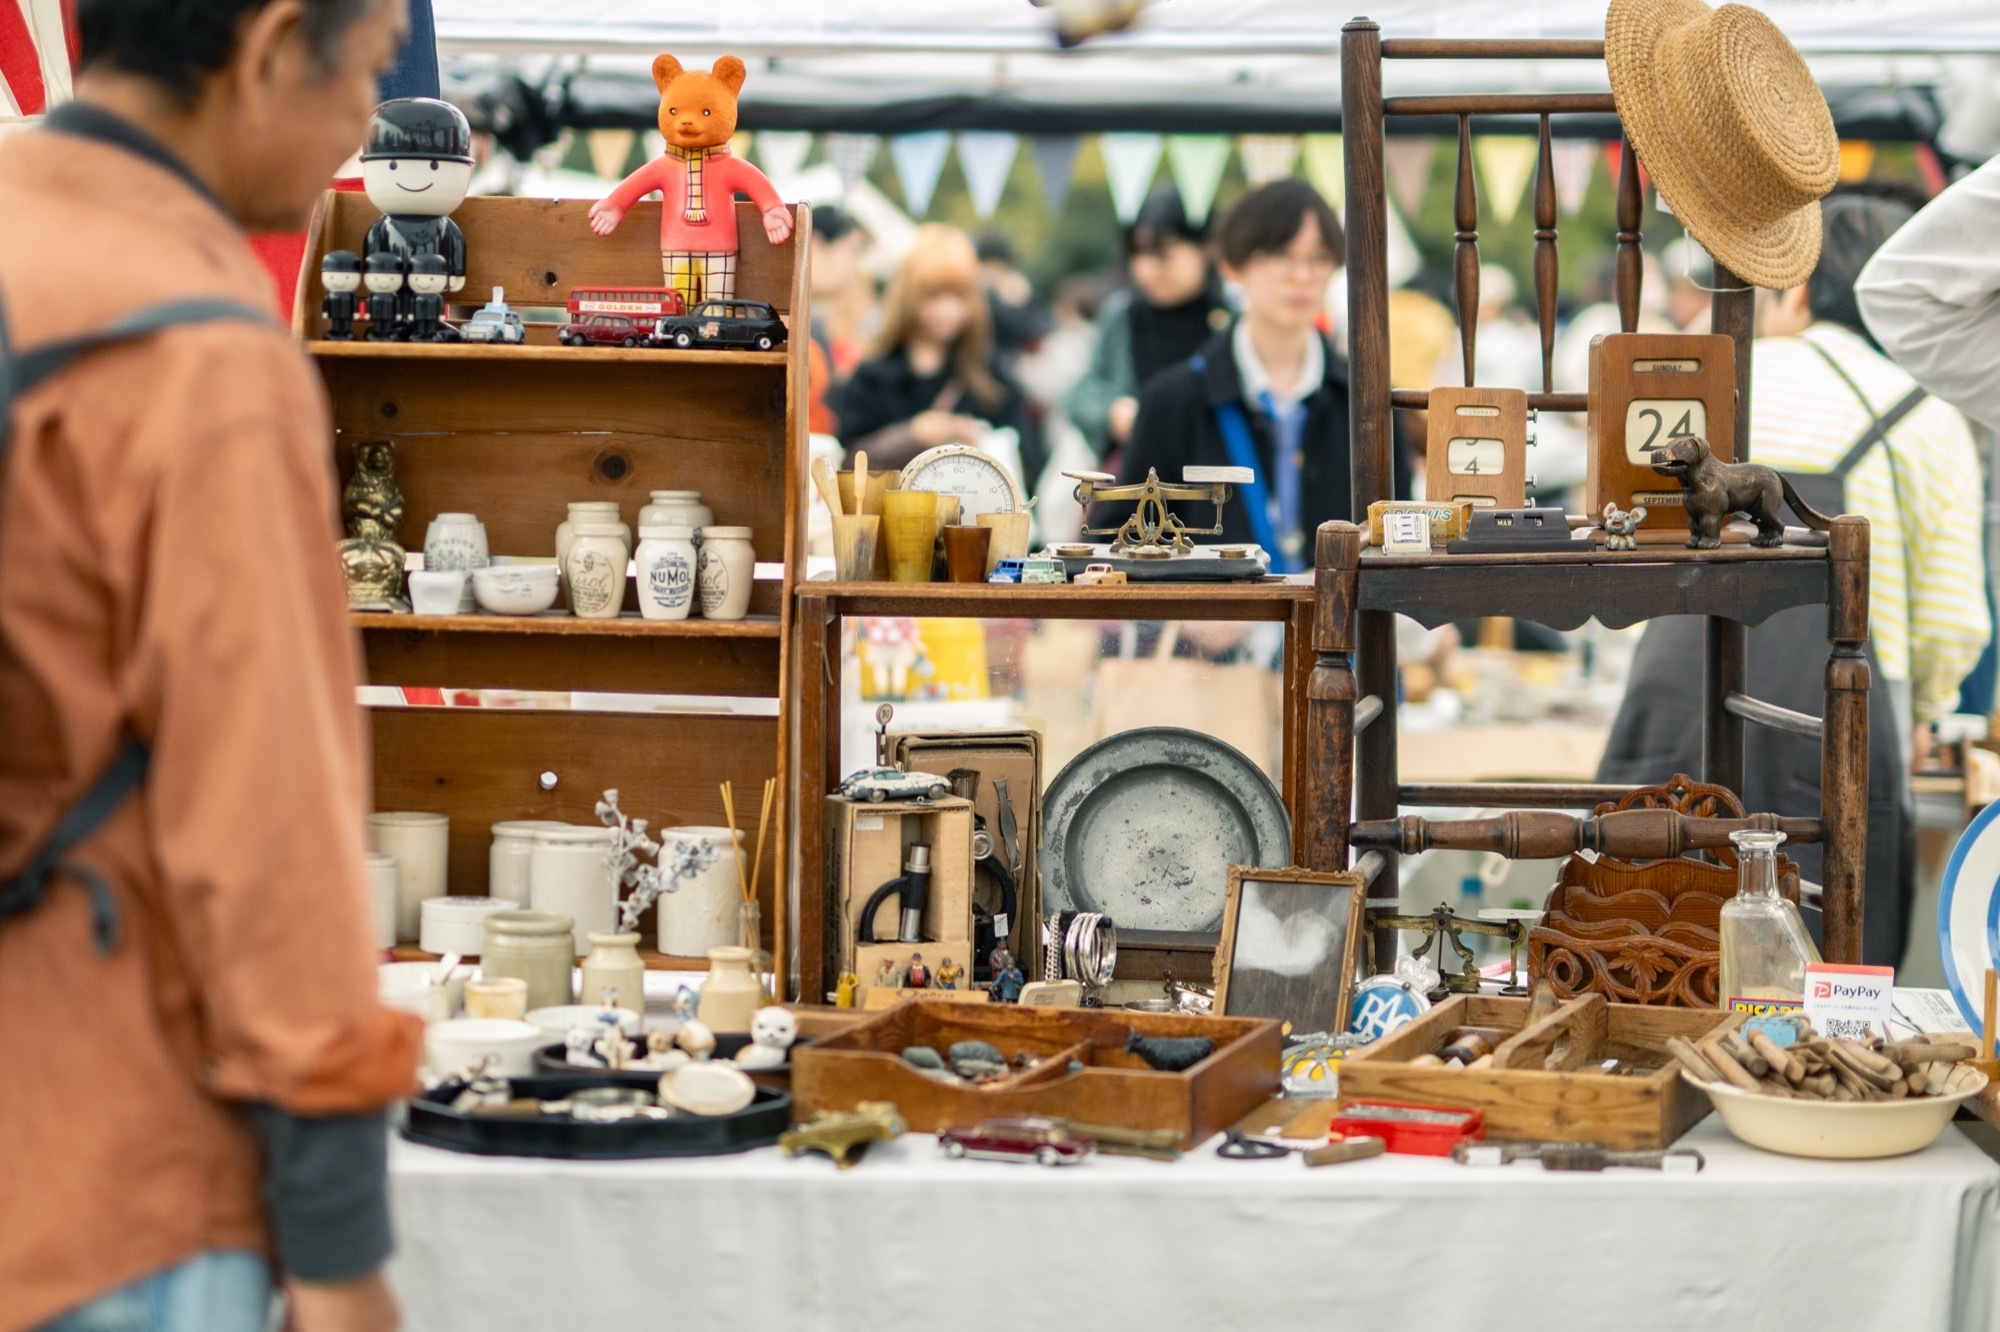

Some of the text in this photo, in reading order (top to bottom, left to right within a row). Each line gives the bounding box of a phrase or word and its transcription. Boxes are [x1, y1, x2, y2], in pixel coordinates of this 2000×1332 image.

[1652, 364, 1682, 372] SUNDAY
[1638, 408, 1696, 452] 24
[953, 466, 966, 474] 60
[1464, 455, 1480, 475] 4
[933, 471, 944, 479] 55
[976, 471, 982, 479] 5
[650, 567, 691, 586] NUMOL
[1833, 984, 1881, 999] PayPay
